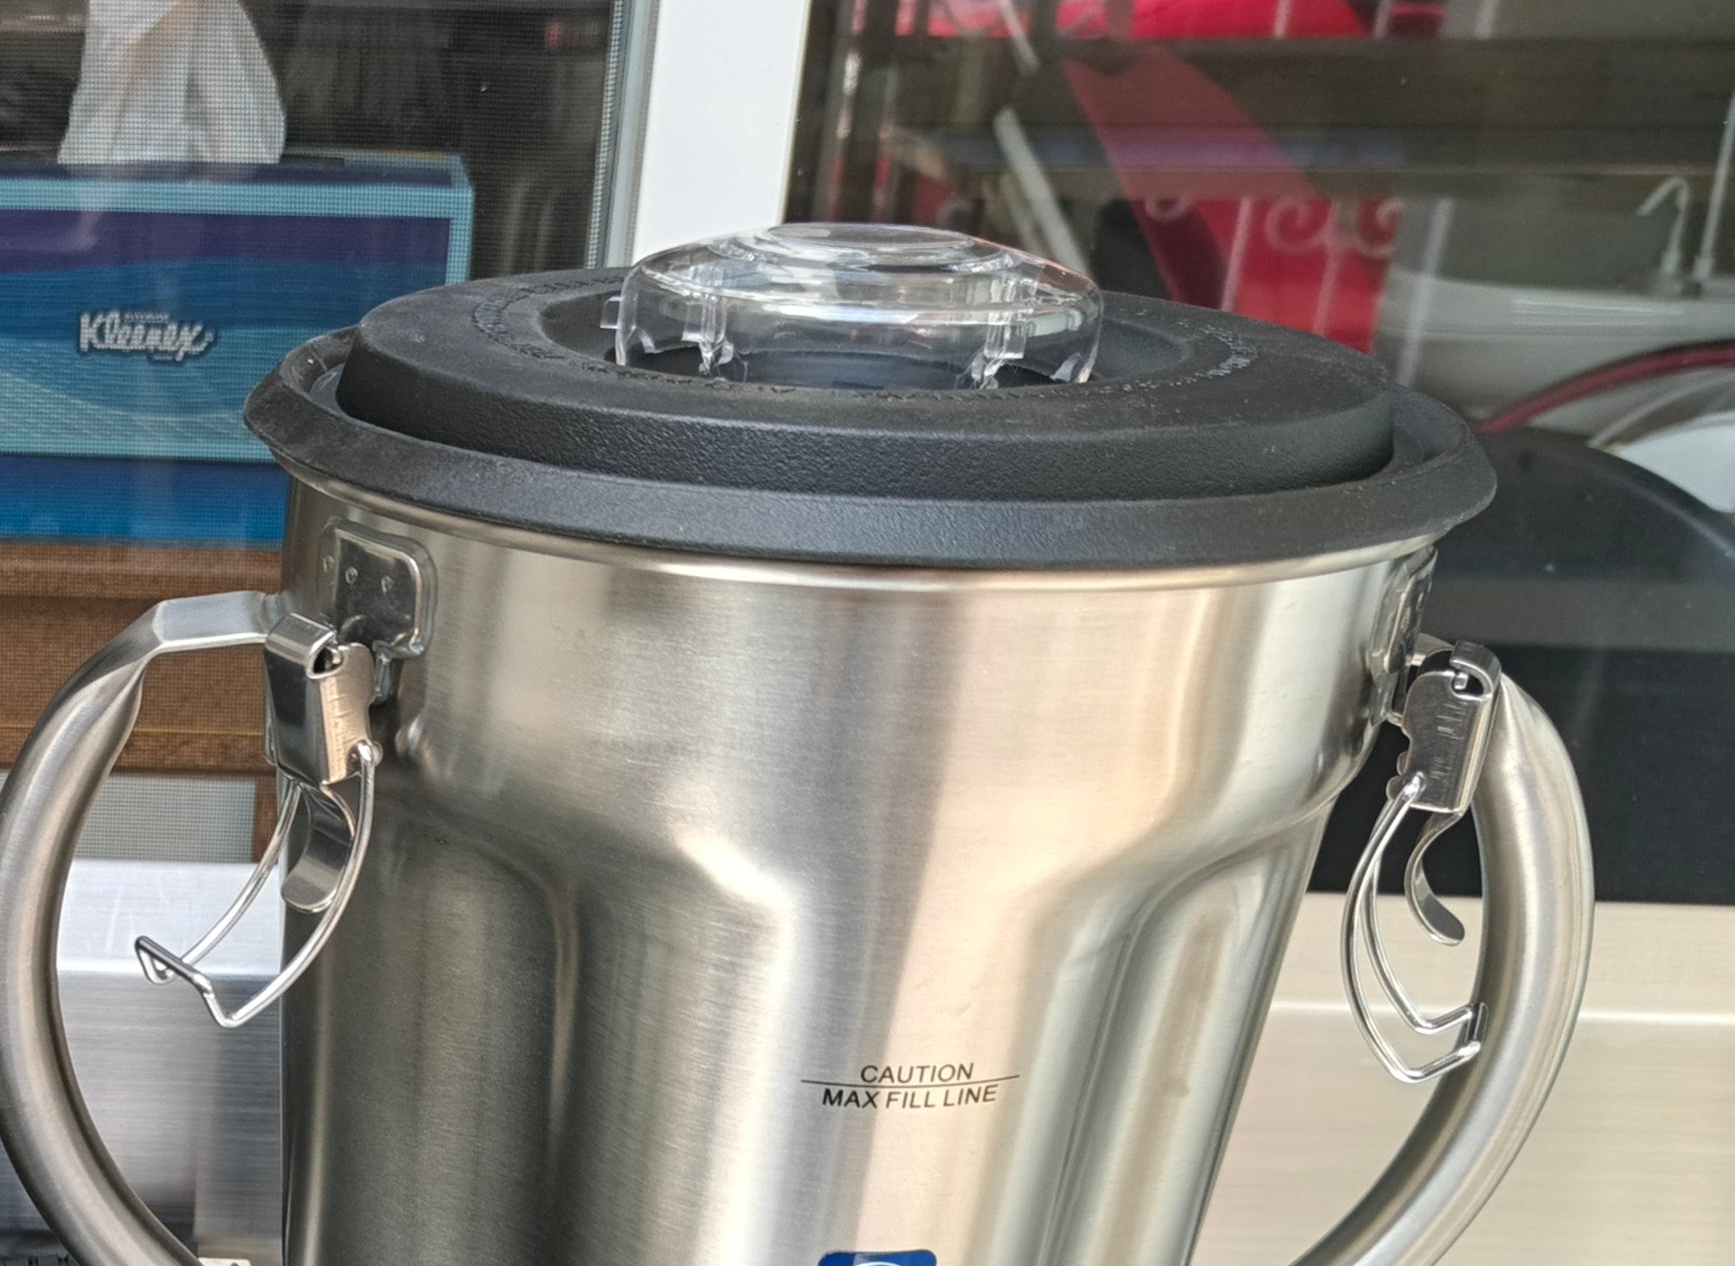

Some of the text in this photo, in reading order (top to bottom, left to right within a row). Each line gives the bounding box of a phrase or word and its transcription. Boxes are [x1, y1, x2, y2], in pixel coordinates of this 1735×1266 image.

[79, 311, 214, 362] Kleenex
[861, 1063, 973, 1083] CAUTION
[822, 1084, 998, 1108] MAX FILL LINE
